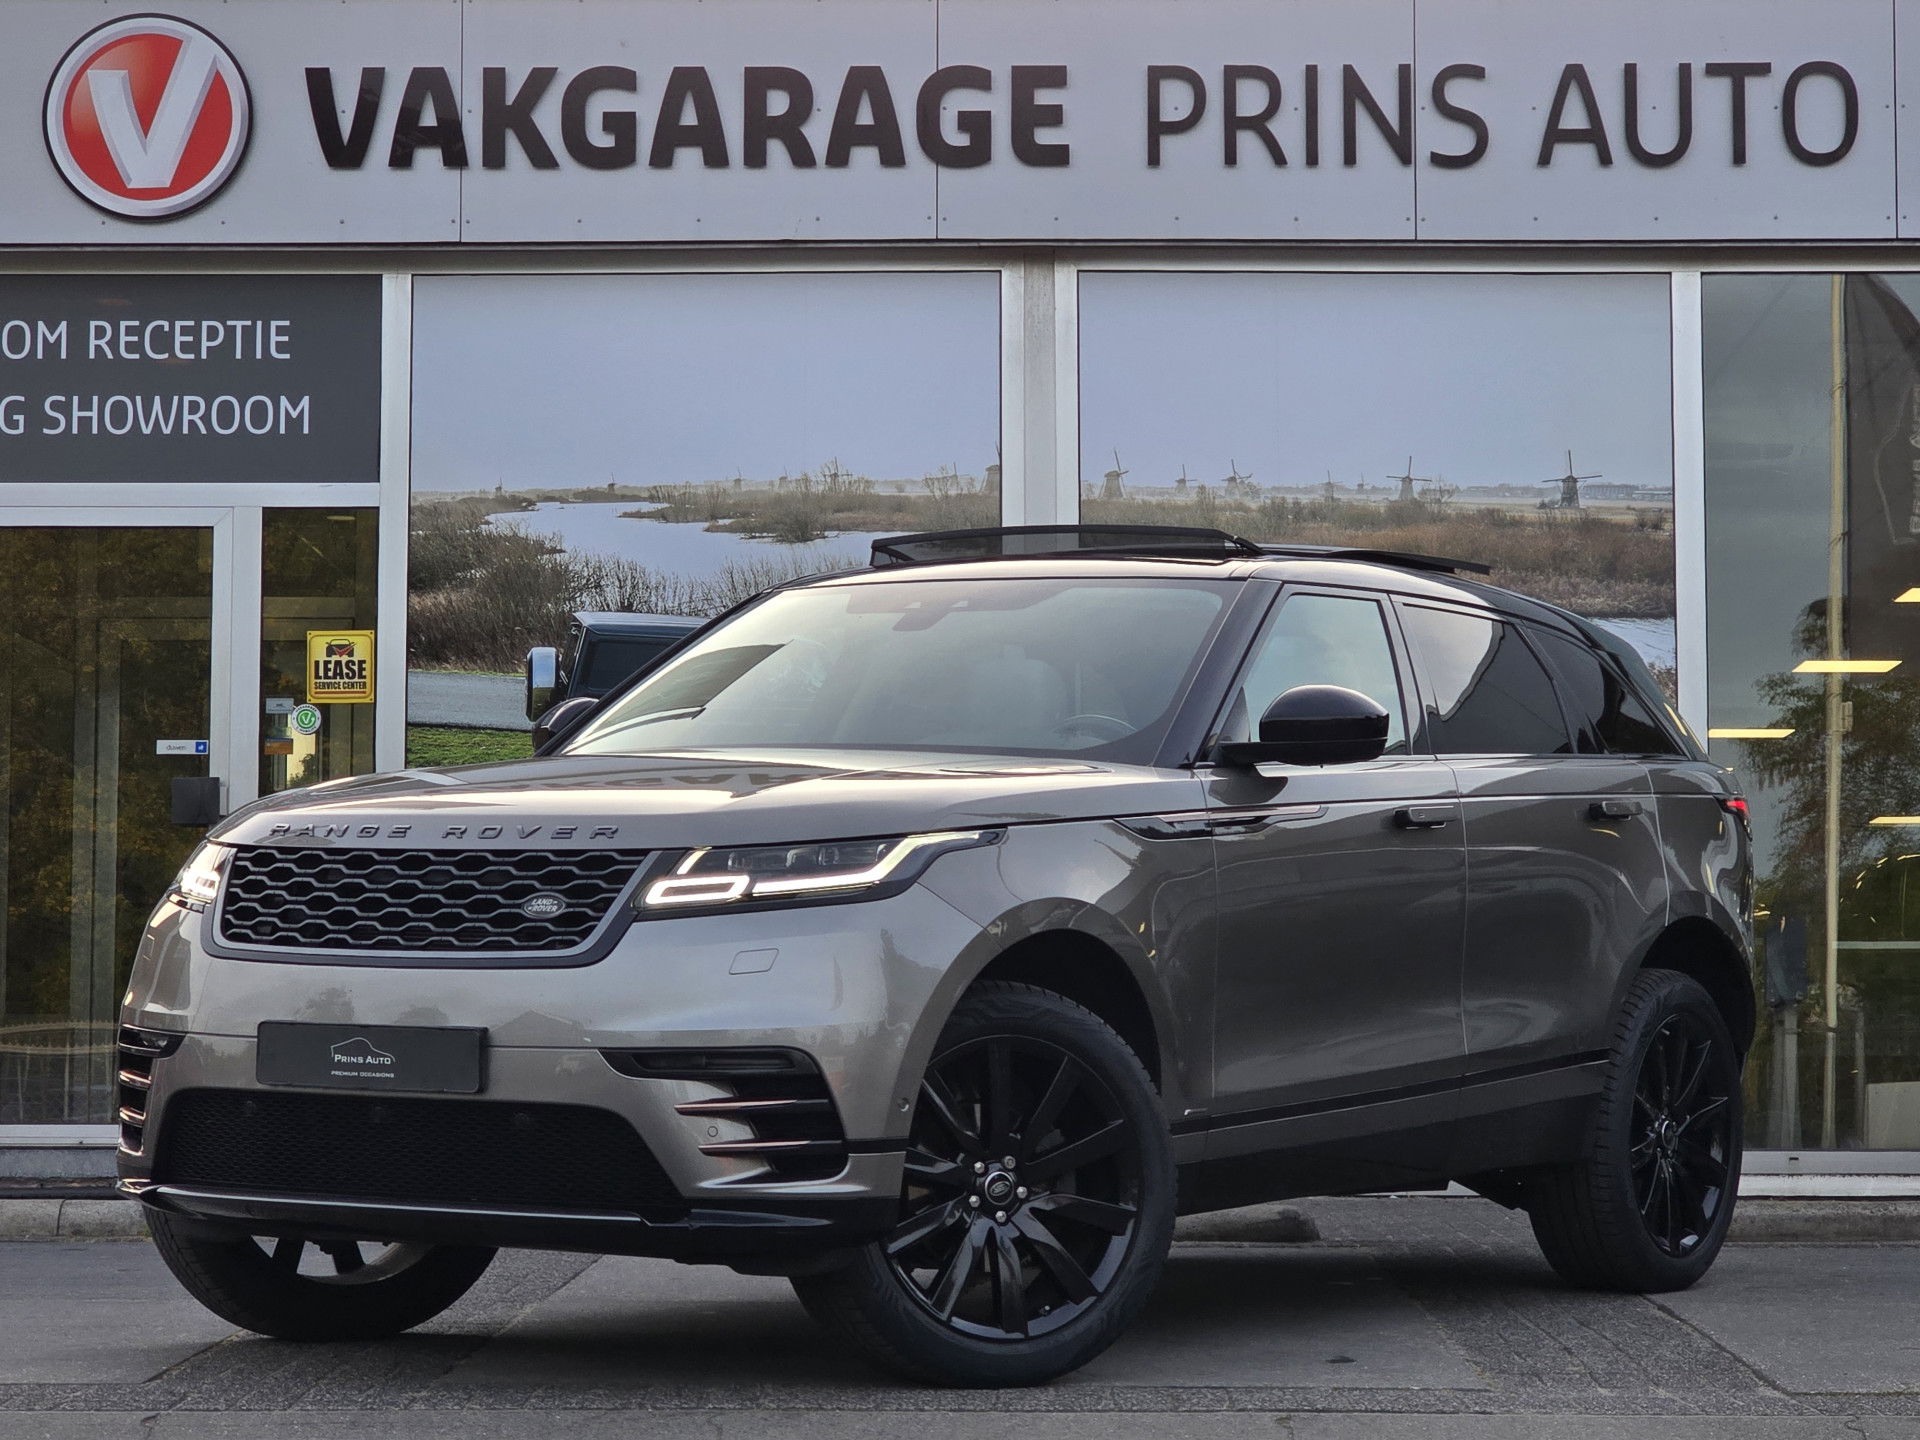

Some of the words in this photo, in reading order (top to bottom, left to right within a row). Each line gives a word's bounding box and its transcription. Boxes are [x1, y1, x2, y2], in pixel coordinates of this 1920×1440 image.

[305, 65, 1070, 171] VAKGARAGE
[1147, 63, 1490, 170] PRINS
[1536, 60, 1860, 170] AUTO
[2, 320, 68, 360] OM
[89, 320, 291, 360] RECEPTIE
[0, 395, 25, 435] G
[43, 395, 310, 435] SHOWROOM
[314, 659, 367, 680] LEASE
[314, 681, 342, 690] SERVICE
[342, 681, 367, 690] CENTER
[269, 823, 412, 838] RANGE
[441, 825, 619, 840] ROVER
[334, 1054, 364, 1064] PRINS
[365, 1055, 392, 1065] AUTO
